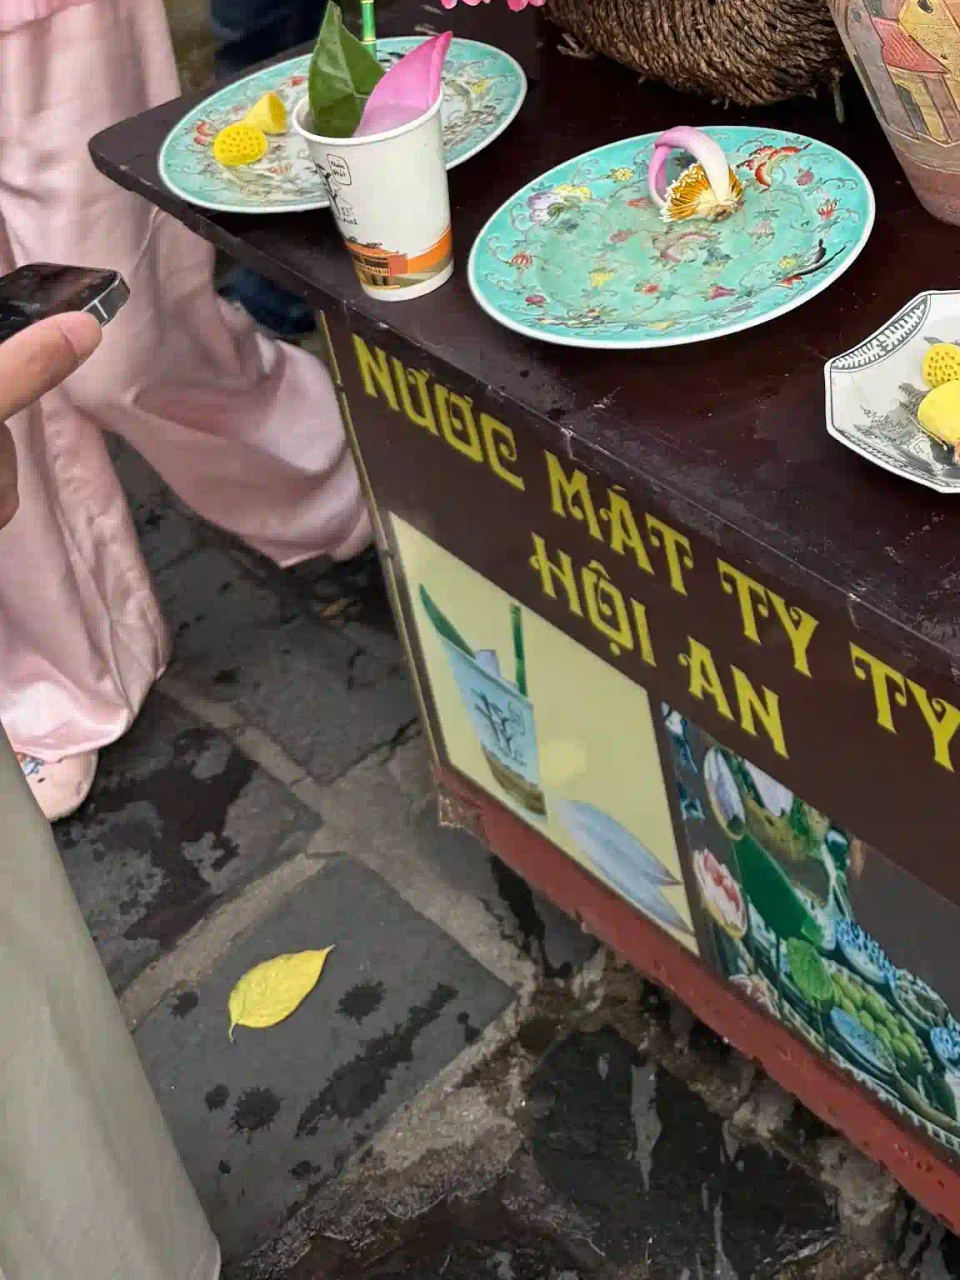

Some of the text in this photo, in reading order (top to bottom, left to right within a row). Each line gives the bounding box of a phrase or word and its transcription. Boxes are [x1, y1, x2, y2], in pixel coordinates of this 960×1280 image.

[528, 531, 790, 760] HỘI AN
[543, 449, 694, 596] MÁT
[718, 558, 820, 678] TY
